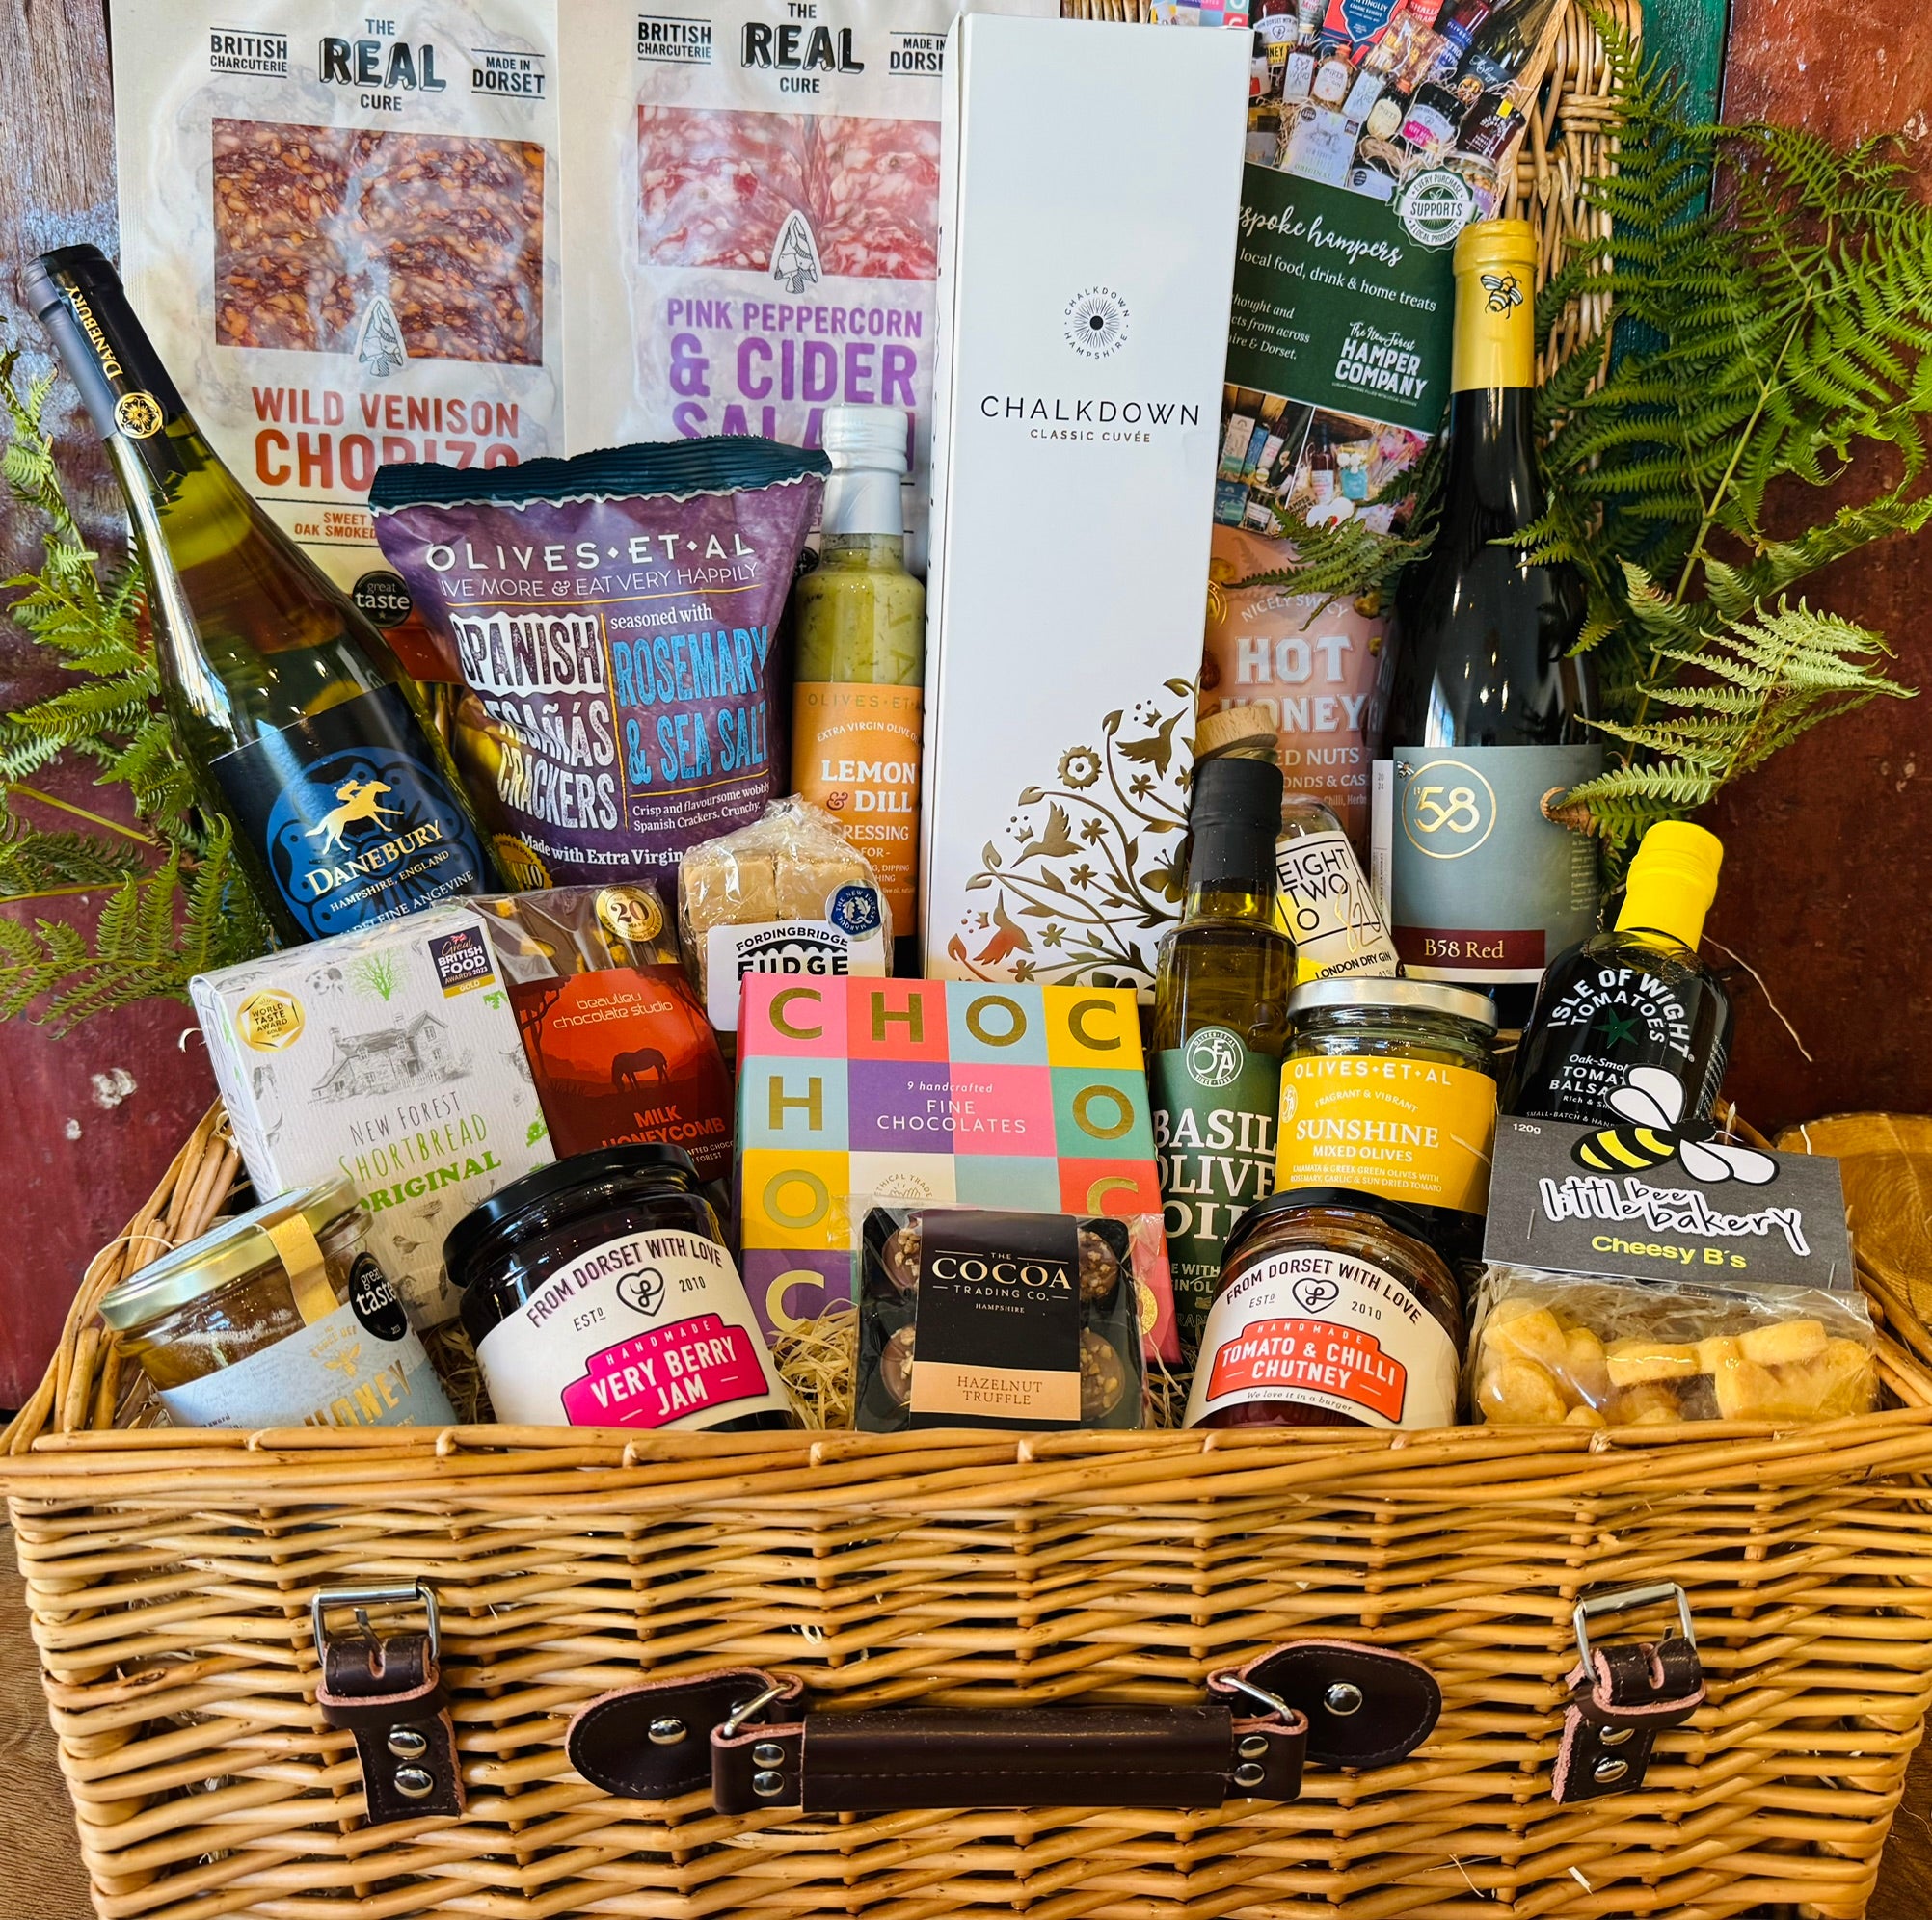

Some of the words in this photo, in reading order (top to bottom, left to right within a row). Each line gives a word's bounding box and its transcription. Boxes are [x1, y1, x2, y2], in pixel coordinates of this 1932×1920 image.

[787, 3, 817, 19] THE
[365, 18, 395, 36] THE
[637, 21, 712, 45] BRITISH
[210, 35, 287, 60] BRITISH
[637, 41, 711, 59] CHARCUTERIE
[740, 22, 865, 75] REAL
[902, 38, 932, 51] MADE
[210, 55, 287, 73] CHARCUTERIE
[319, 37, 446, 93] REAL
[486, 56, 515, 70] MADE
[518, 58, 530, 71] IN
[472, 69, 545, 93] DORSET
[779, 76, 820, 93] CURE
[360, 94, 402, 111] CURE
[1414, 175, 1433, 192] EVERY
[1434, 174, 1462, 194] PURCHASE
[1410, 201, 1462, 217] SUPPORTS
[1307, 215, 1403, 267] hampers
[1240, 248, 1272, 267] local
[1274, 256, 1306, 280] food,
[1310, 266, 1344, 288] drink
[1360, 280, 1397, 301] home
[1399, 290, 1436, 312] treats
[1064, 286, 1130, 318] CHALKDOWN
[1273, 305, 1296, 320] and
[667, 298, 733, 329] PINK
[743, 301, 923, 338] PEPPERCORN
[1247, 317, 1275, 334] from
[1275, 326, 1311, 343] across
[65, 286, 123, 381] DANEBURY
[1064, 332, 1128, 360] HAMPSHIRE
[1350, 321, 1366, 338] The
[1383, 331, 1416, 351] Forest
[1260, 341, 1298, 360] Dorset.
[1340, 337, 1421, 377] HAMPER
[669, 332, 711, 398] &
[736, 336, 918, 407] CIDER
[1335, 359, 1429, 400] COMPANY
[252, 387, 344, 426] WILD
[360, 393, 519, 438] VENISON
[981, 396, 1199, 425] CHALKDOWN
[1031, 429, 1093, 440] CLASSIC
[1102, 430, 1151, 442] CUVÉE
[323, 512, 367, 525] SWEET
[295, 523, 320, 536] OAK
[325, 526, 377, 540] SMOKED
[366, 580, 396, 596] great
[481, 578, 546, 598] MORE
[551, 578, 571, 595] &
[577, 576, 612, 596] EAT
[612, 573, 673, 595] VERY
[677, 562, 757, 586] HAPPILY
[356, 591, 410, 611] taste
[1241, 595, 1292, 623] NICELY
[611, 607, 678, 630] seasoned
[679, 603, 713, 623] with
[451, 620, 602, 686] SPANISH
[1235, 636, 1354, 685] HOT
[612, 626, 768, 707] ROSEMARY
[627, 719, 653, 786] &
[657, 713, 712, 782] SEA
[718, 700, 768, 772] SALT
[817, 726, 845, 742] EXTRA
[847, 722, 884, 732] VIRGIN
[887, 723, 910, 737] OLIVE
[1306, 748, 1360, 766] NUTS
[821, 760, 915, 784] LEMON
[497, 742, 618, 831] CRACKERS
[633, 805, 661, 817] Crisp
[664, 802, 683, 813] and
[684, 790, 740, 813] flavoursome
[742, 782, 769, 798] wobbly
[826, 791, 848, 811] &
[855, 791, 911, 813] DILL
[634, 820, 675, 833] Spanish
[677, 812, 720, 827] Crackers.
[305, 820, 443, 896] DANEBURY
[521, 831, 550, 856] Made
[551, 846, 584, 863] with
[586, 849, 629, 865] Extra
[631, 847, 684, 866] Virgin
[1277, 849, 1349, 887] EIGHT
[330, 878, 398, 913] HAMPSHIRE,
[399, 851, 449, 881] ENGLAND
[413, 871, 474, 909] ANGEVINE
[1283, 873, 1348, 908] TWO
[611, 900, 649, 922] 20
[736, 926, 848, 952] FORDINGBRIDGE
[1425, 939, 1460, 958] B58
[1466, 942, 1504, 959] Red
[438, 946, 483, 967] BRITISH
[440, 956, 486, 978] FOOD
[738, 956, 848, 982] FUDGE
[1315, 958, 1360, 979] LONDON
[1360, 953, 1378, 967] DRY
[444, 972, 471, 984] AWARDS
[459, 980, 480, 993] GOLD
[252, 1003, 283, 1018] WORLD
[576, 991, 642, 1011] beaulieu
[1547, 979, 1594, 1028] ISLE
[1598, 969, 1633, 987] OF
[1639, 973, 1690, 1058] WIGHT
[254, 1010, 285, 1026] TASTE
[256, 1018, 288, 1032] AWARD
[552, 1008, 630, 1029] chocolate
[631, 1000, 674, 1017] studio
[1570, 991, 1665, 1044] TOMATOES
[907, 1081, 914, 1090] 9
[919, 1081, 994, 1093] handcrafted
[926, 1100, 975, 1115] FINE
[1315, 1089, 1360, 1108] FRAGRANT
[1375, 1091, 1418, 1112] VIBRANT
[349, 1115, 390, 1147] NEW
[397, 1090, 462, 1130] FOREST
[633, 1105, 683, 1128] MILK
[876, 1115, 1026, 1133] CHOCOLATES
[1153, 1108, 1276, 1157] BASIL
[1297, 1118, 1439, 1148] SUNSHINE
[1512, 1123, 1541, 1136] 120g
[338, 1113, 488, 1184] SHORTBREAD
[1313, 1145, 1356, 1158] MIXED
[1360, 1146, 1413, 1162] OLIVES
[1357, 1166, 1385, 1176] GREEN
[1388, 1168, 1417, 1180] OLIVES
[1362, 1176, 1380, 1185] SUN
[1382, 1178, 1409, 1188] DRIED
[910, 1175, 932, 1197] TRADE
[1543, 1182, 1642, 1218] little
[1633, 1182, 1687, 1202] bee
[1650, 1192, 1803, 1252] bakery
[1592, 1236, 1695, 1266] Cheesy
[526, 1279, 576, 1328] FROM
[573, 1242, 644, 1289] DORSET
[645, 1239, 686, 1260] WITH
[689, 1240, 724, 1268] LOVE
[679, 1276, 706, 1293] 2010
[932, 1257, 1072, 1290] COCOA
[356, 1282, 396, 1316] taste
[954, 1285, 1020, 1298] TRADING
[1028, 1291, 1050, 1302] CO.
[1226, 1269, 1263, 1305] FROM
[1269, 1258, 1333, 1278] DORSET
[1338, 1263, 1382, 1291] WITH
[1383, 1284, 1422, 1325] LOVE
[975, 1303, 1025, 1314] HAMPSHIRE
[1352, 1301, 1382, 1320] 2010
[606, 1320, 711, 1366] HANDMADE
[1257, 1323, 1363, 1345] HANDMADE
[590, 1357, 657, 1410] VERY
[664, 1336, 738, 1378] BERRY
[1221, 1337, 1295, 1368] TOMATO
[1302, 1343, 1316, 1358] &
[1326, 1343, 1396, 1387] CHILLI
[1251, 1360, 1352, 1389] CHUTNEY
[658, 1374, 709, 1417] JAM
[957, 1376, 1043, 1392] HAZELNUT
[963, 1390, 1031, 1405] TRUFFLE
[1248, 1391, 1261, 1400] We
[1318, 1396, 1353, 1412] burger
